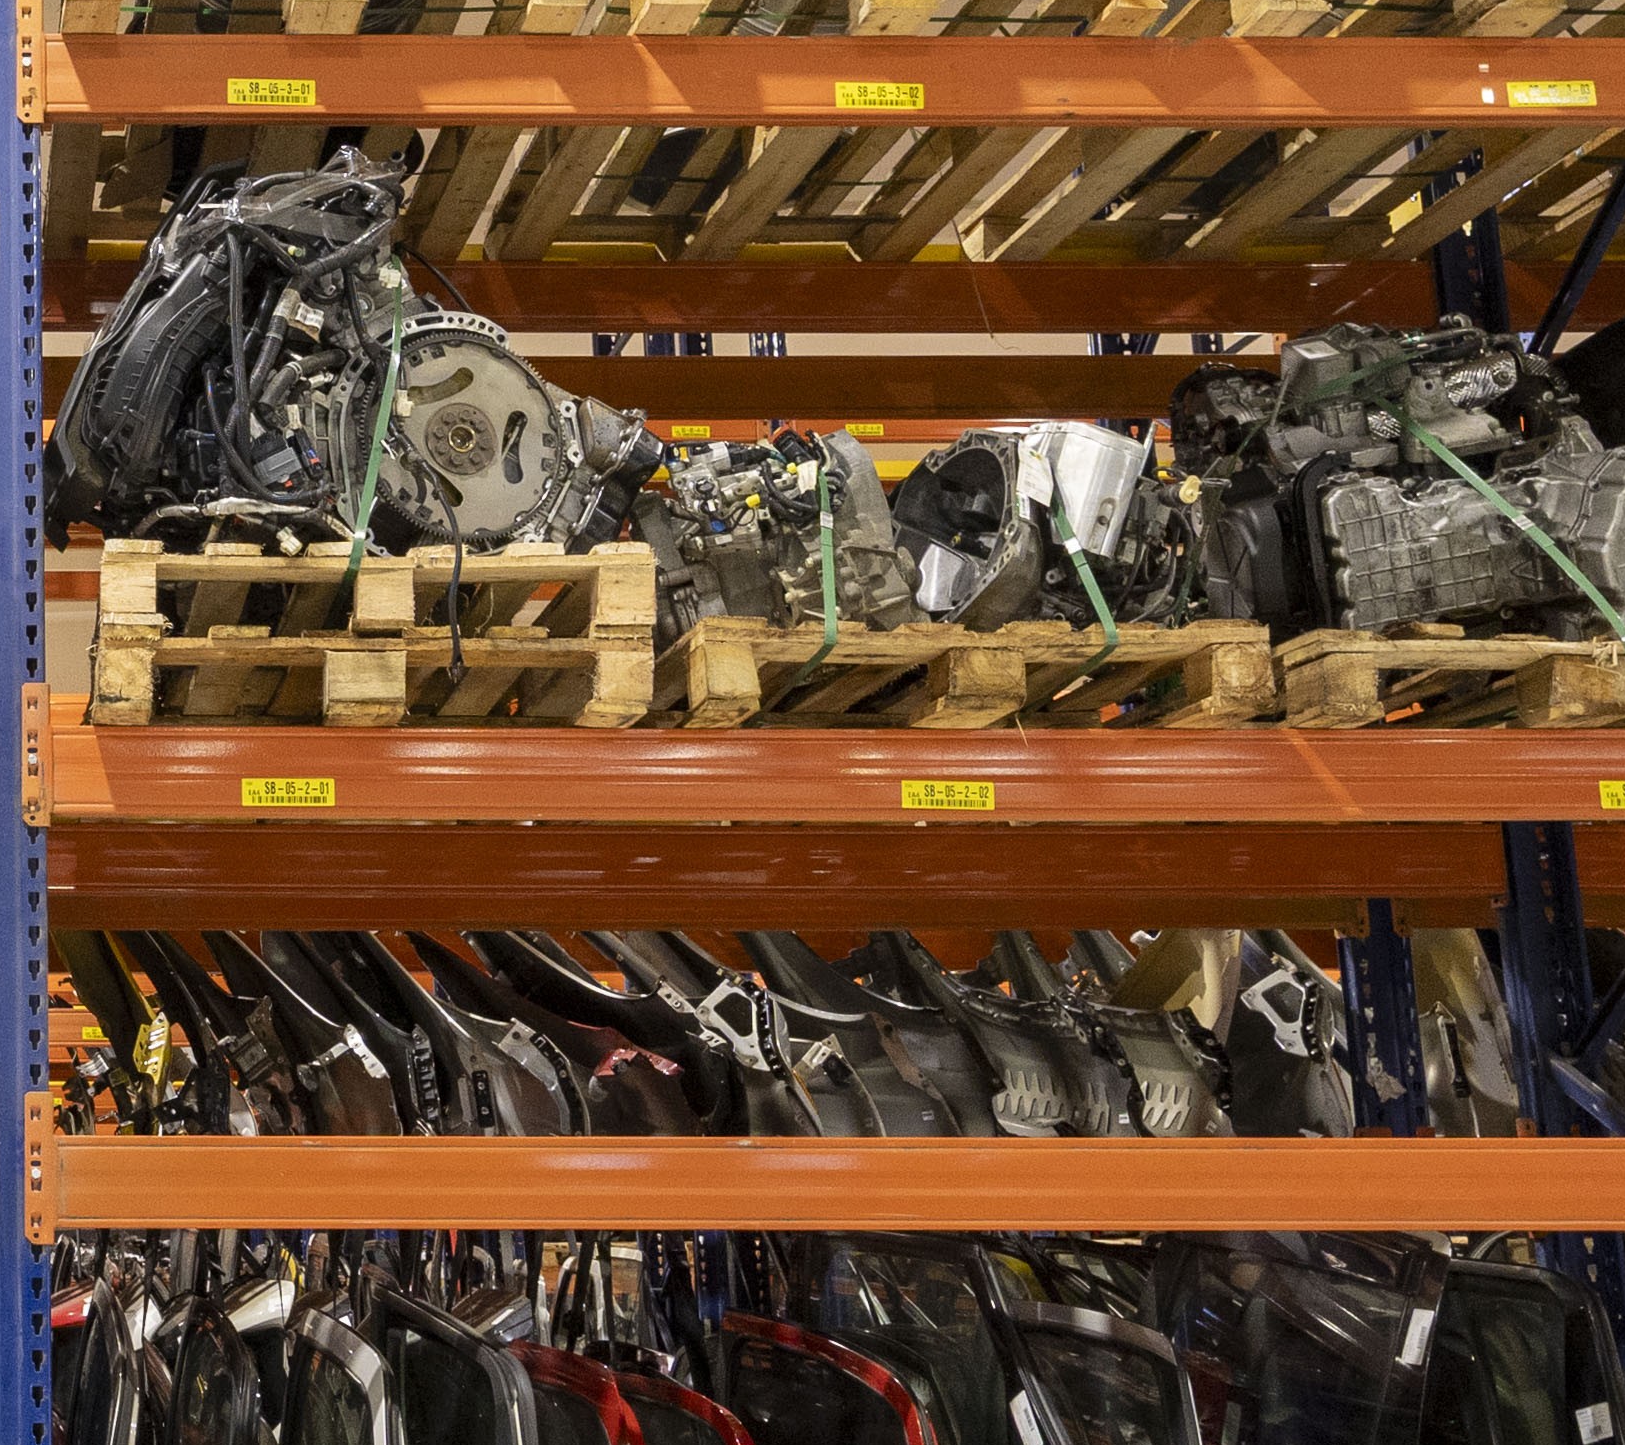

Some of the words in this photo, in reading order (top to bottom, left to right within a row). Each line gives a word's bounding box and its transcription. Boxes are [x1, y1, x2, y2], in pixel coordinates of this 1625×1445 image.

[248, 81, 311, 95] SB-05-3-01
[856, 85, 919, 98] SB-05-3-02
[264, 781, 330, 795] SB-05-2-01
[923, 784, 990, 799] SB-05-2-02
